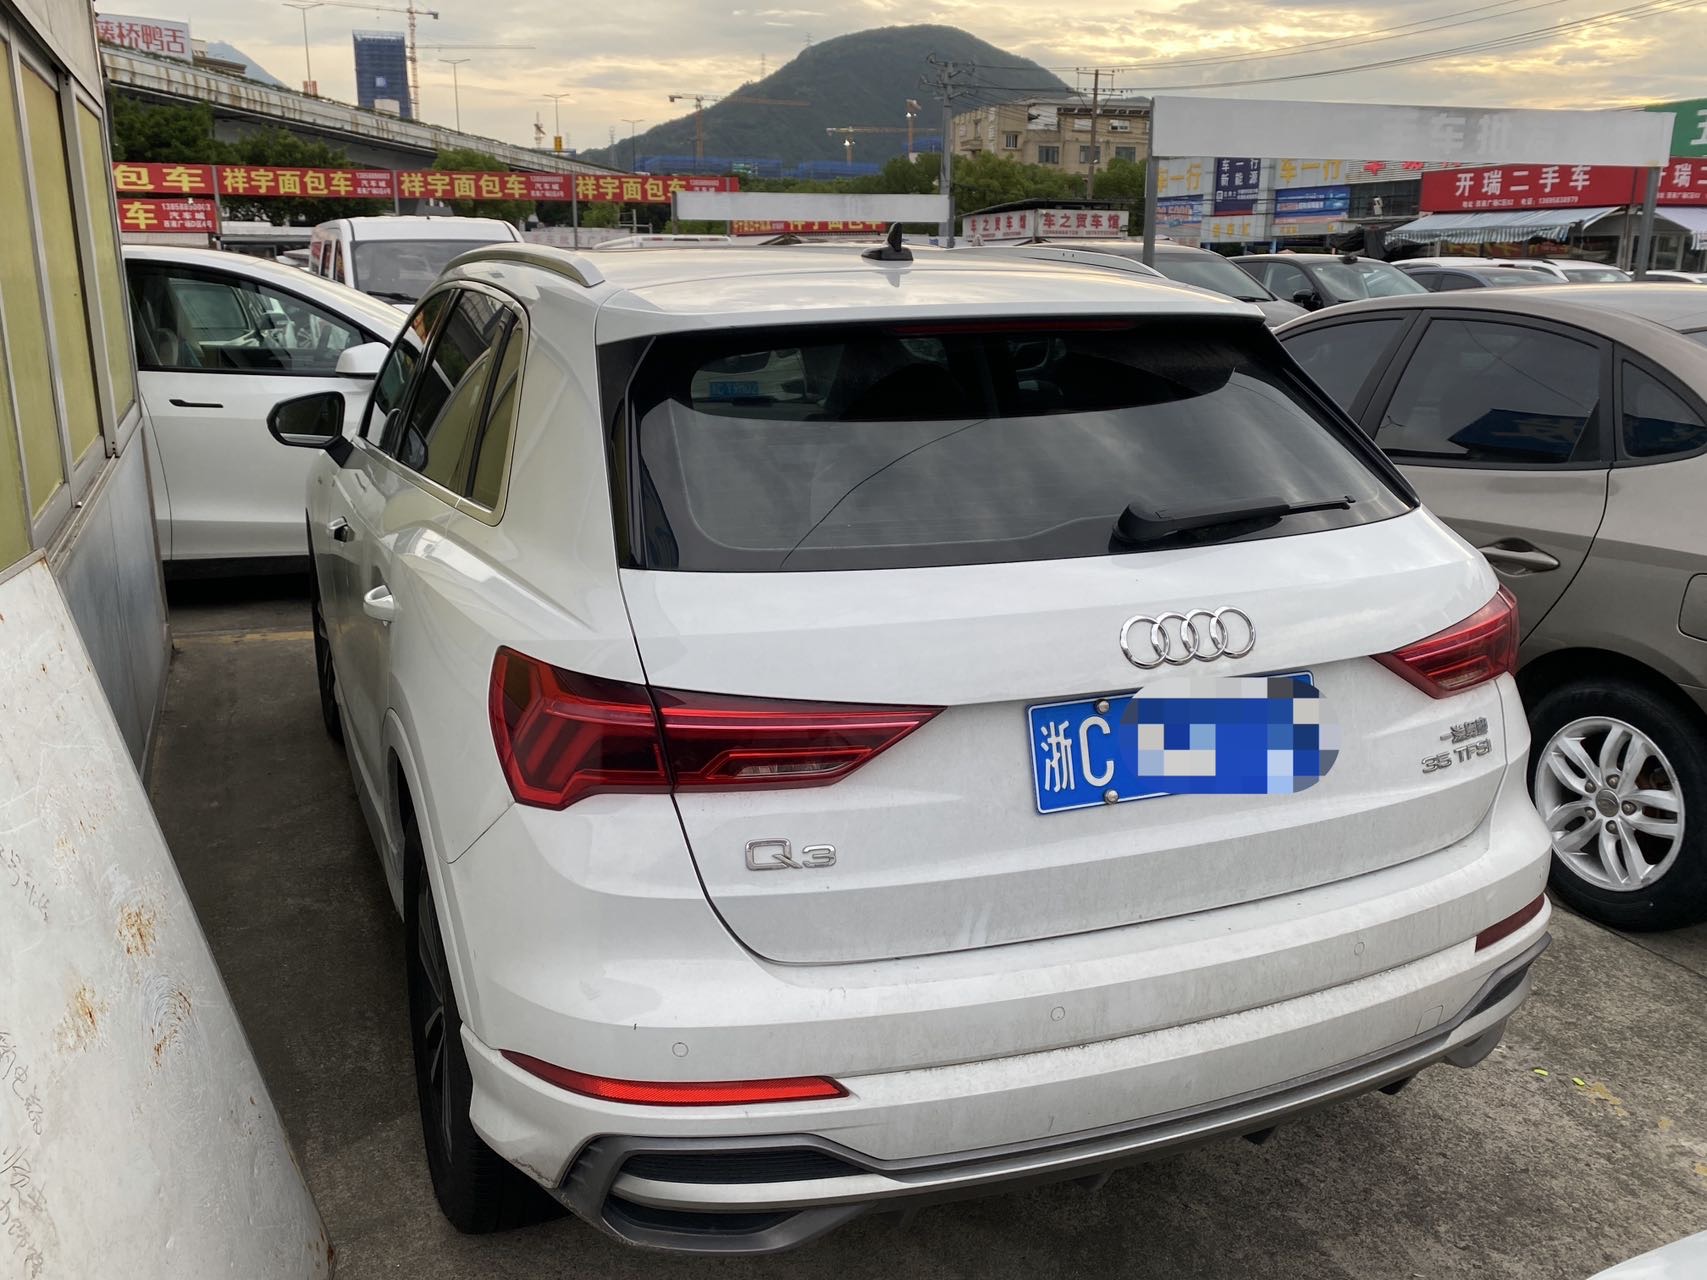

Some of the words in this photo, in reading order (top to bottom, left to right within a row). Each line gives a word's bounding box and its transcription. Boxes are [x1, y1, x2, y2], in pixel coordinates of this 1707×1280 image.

[223, 168, 354, 195] 祥宇面包车
[400, 173, 527, 198] 祥宇面包车
[1455, 165, 1591, 197] 开瑞二手车
[122, 201, 158, 229] 车
[1421, 751, 1453, 774] 35
[745, 838, 836, 871] Q3
